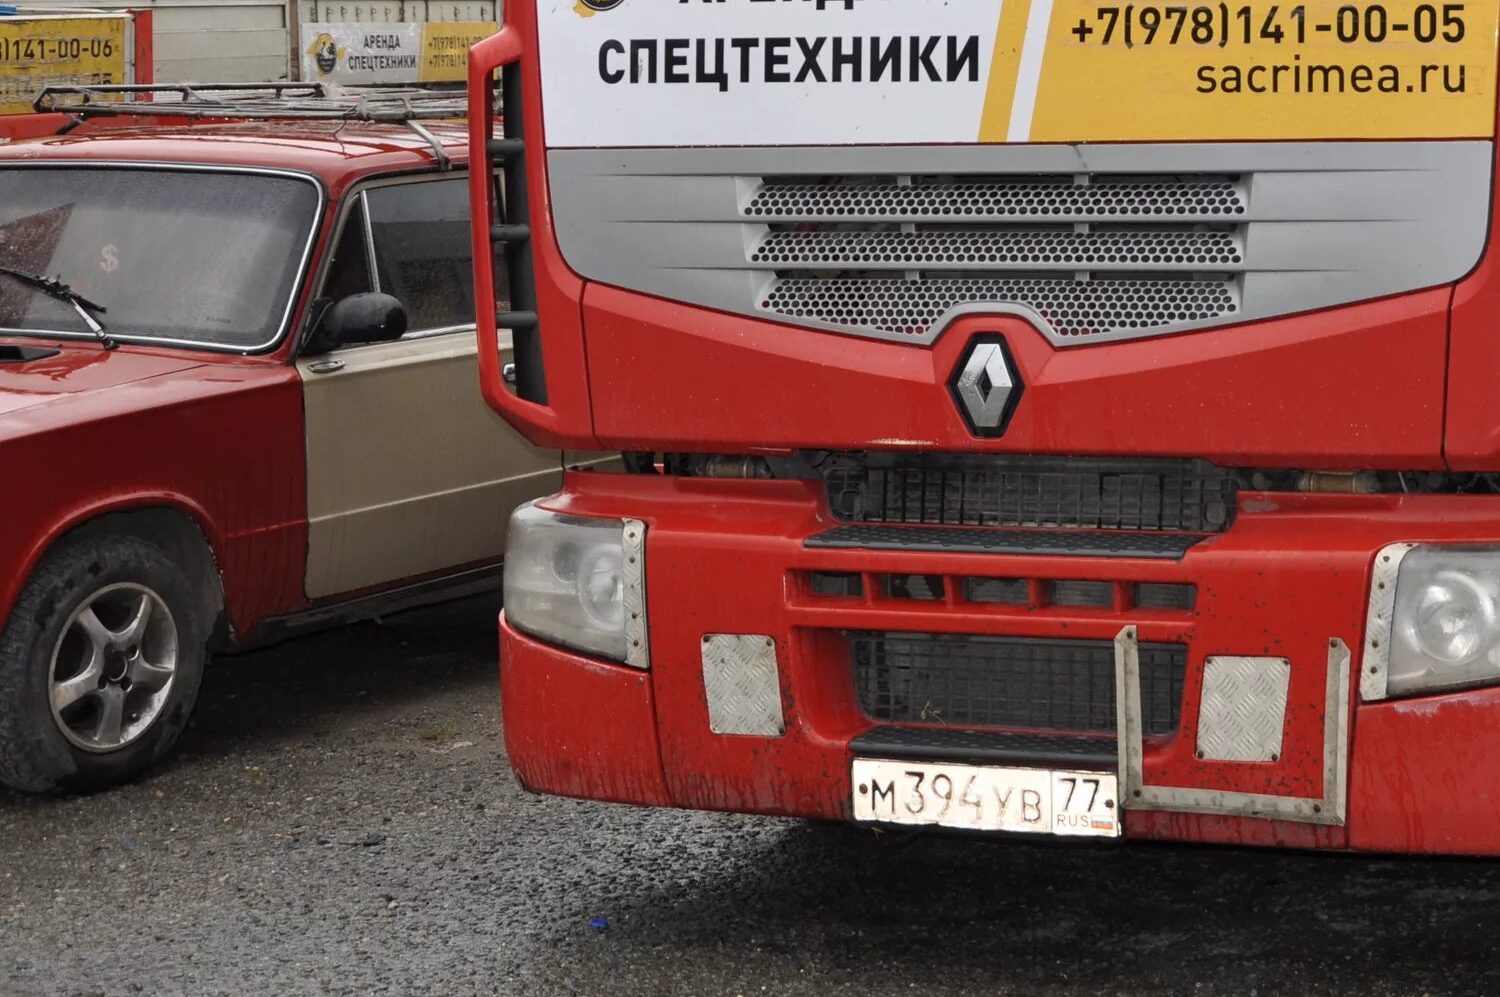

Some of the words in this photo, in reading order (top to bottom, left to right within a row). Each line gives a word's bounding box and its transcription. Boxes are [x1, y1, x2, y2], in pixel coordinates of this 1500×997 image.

[363, 35, 400, 51] АРЕНДА
[1072, 2, 1466, 50] +7(978)141-00-05
[348, 54, 417, 72] СПЕЦТЕХНИКИ
[598, 35, 980, 92] СПЕЦТЕХНИКИ
[1197, 55, 1466, 94] sacrimea.ru
[1058, 778, 1100, 812] 77
[1056, 813, 1089, 828] RUS
